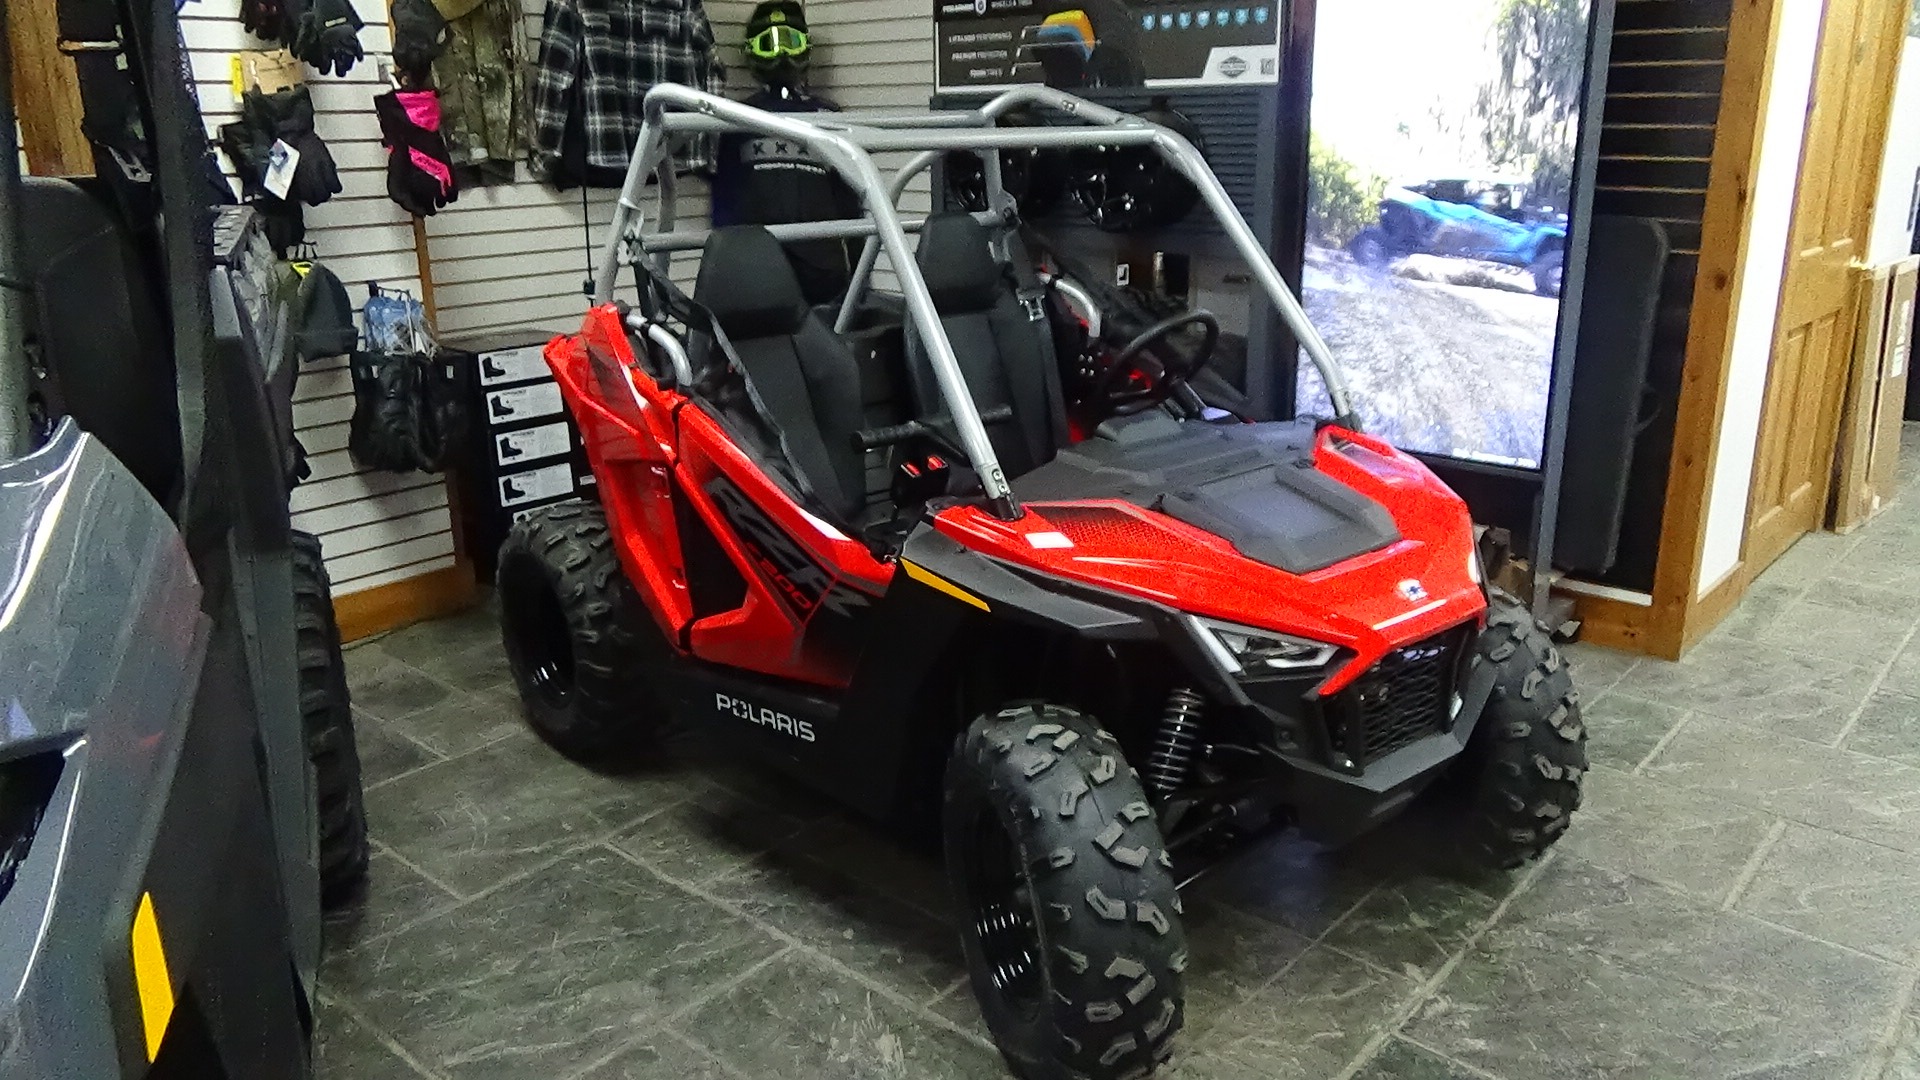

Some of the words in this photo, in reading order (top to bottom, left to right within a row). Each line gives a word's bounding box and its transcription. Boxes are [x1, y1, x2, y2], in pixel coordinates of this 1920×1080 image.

[703, 476, 871, 618] RZR
[758, 556, 812, 609] 200
[716, 692, 816, 742] POLARIS
